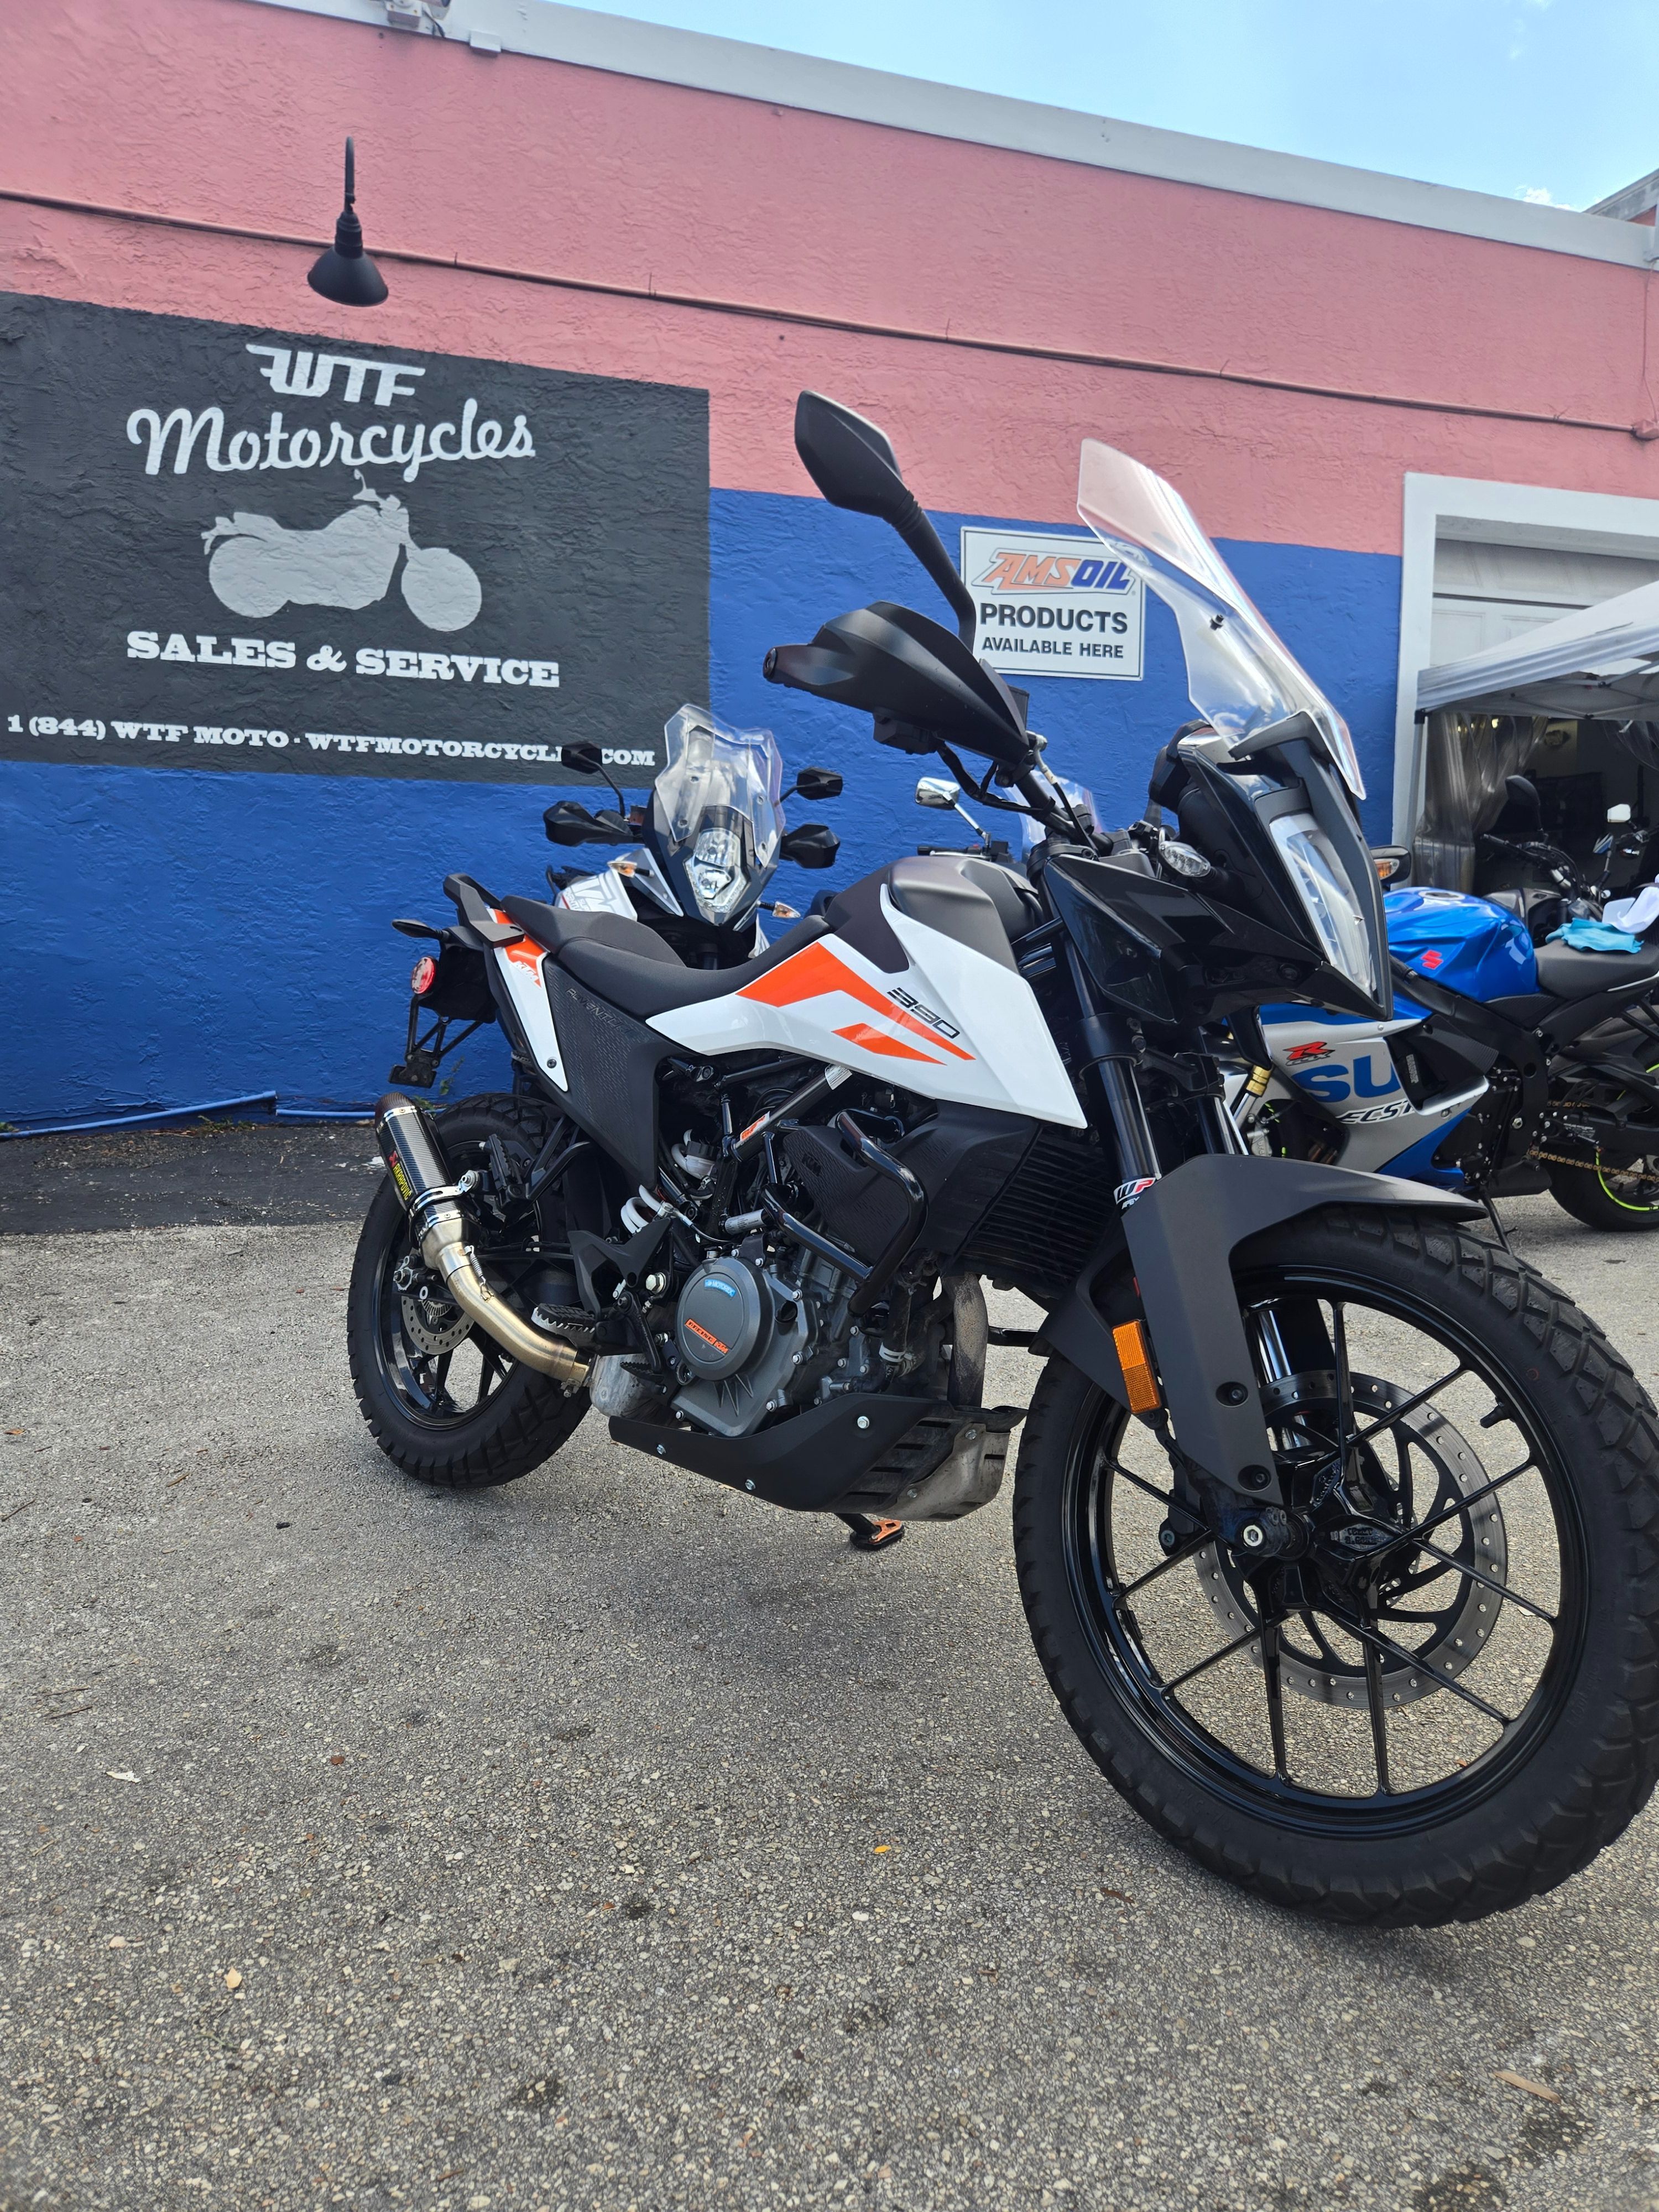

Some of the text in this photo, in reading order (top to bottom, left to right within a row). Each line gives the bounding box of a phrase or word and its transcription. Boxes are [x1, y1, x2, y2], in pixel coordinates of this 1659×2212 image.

[246, 343, 426, 406] WTF
[127, 398, 536, 482] Motorcycles
[982, 551, 1131, 591] AMSOIL
[980, 603, 1128, 634] PRODUCTS
[127, 631, 560, 687] SALES & SERVICE
[981, 637, 1124, 659] AVAILABLE HERE
[8, 714, 655, 766] 1 (844) WTF MOTO WTFMOTORCYCLCOM
[886, 987, 961, 1039] 390
